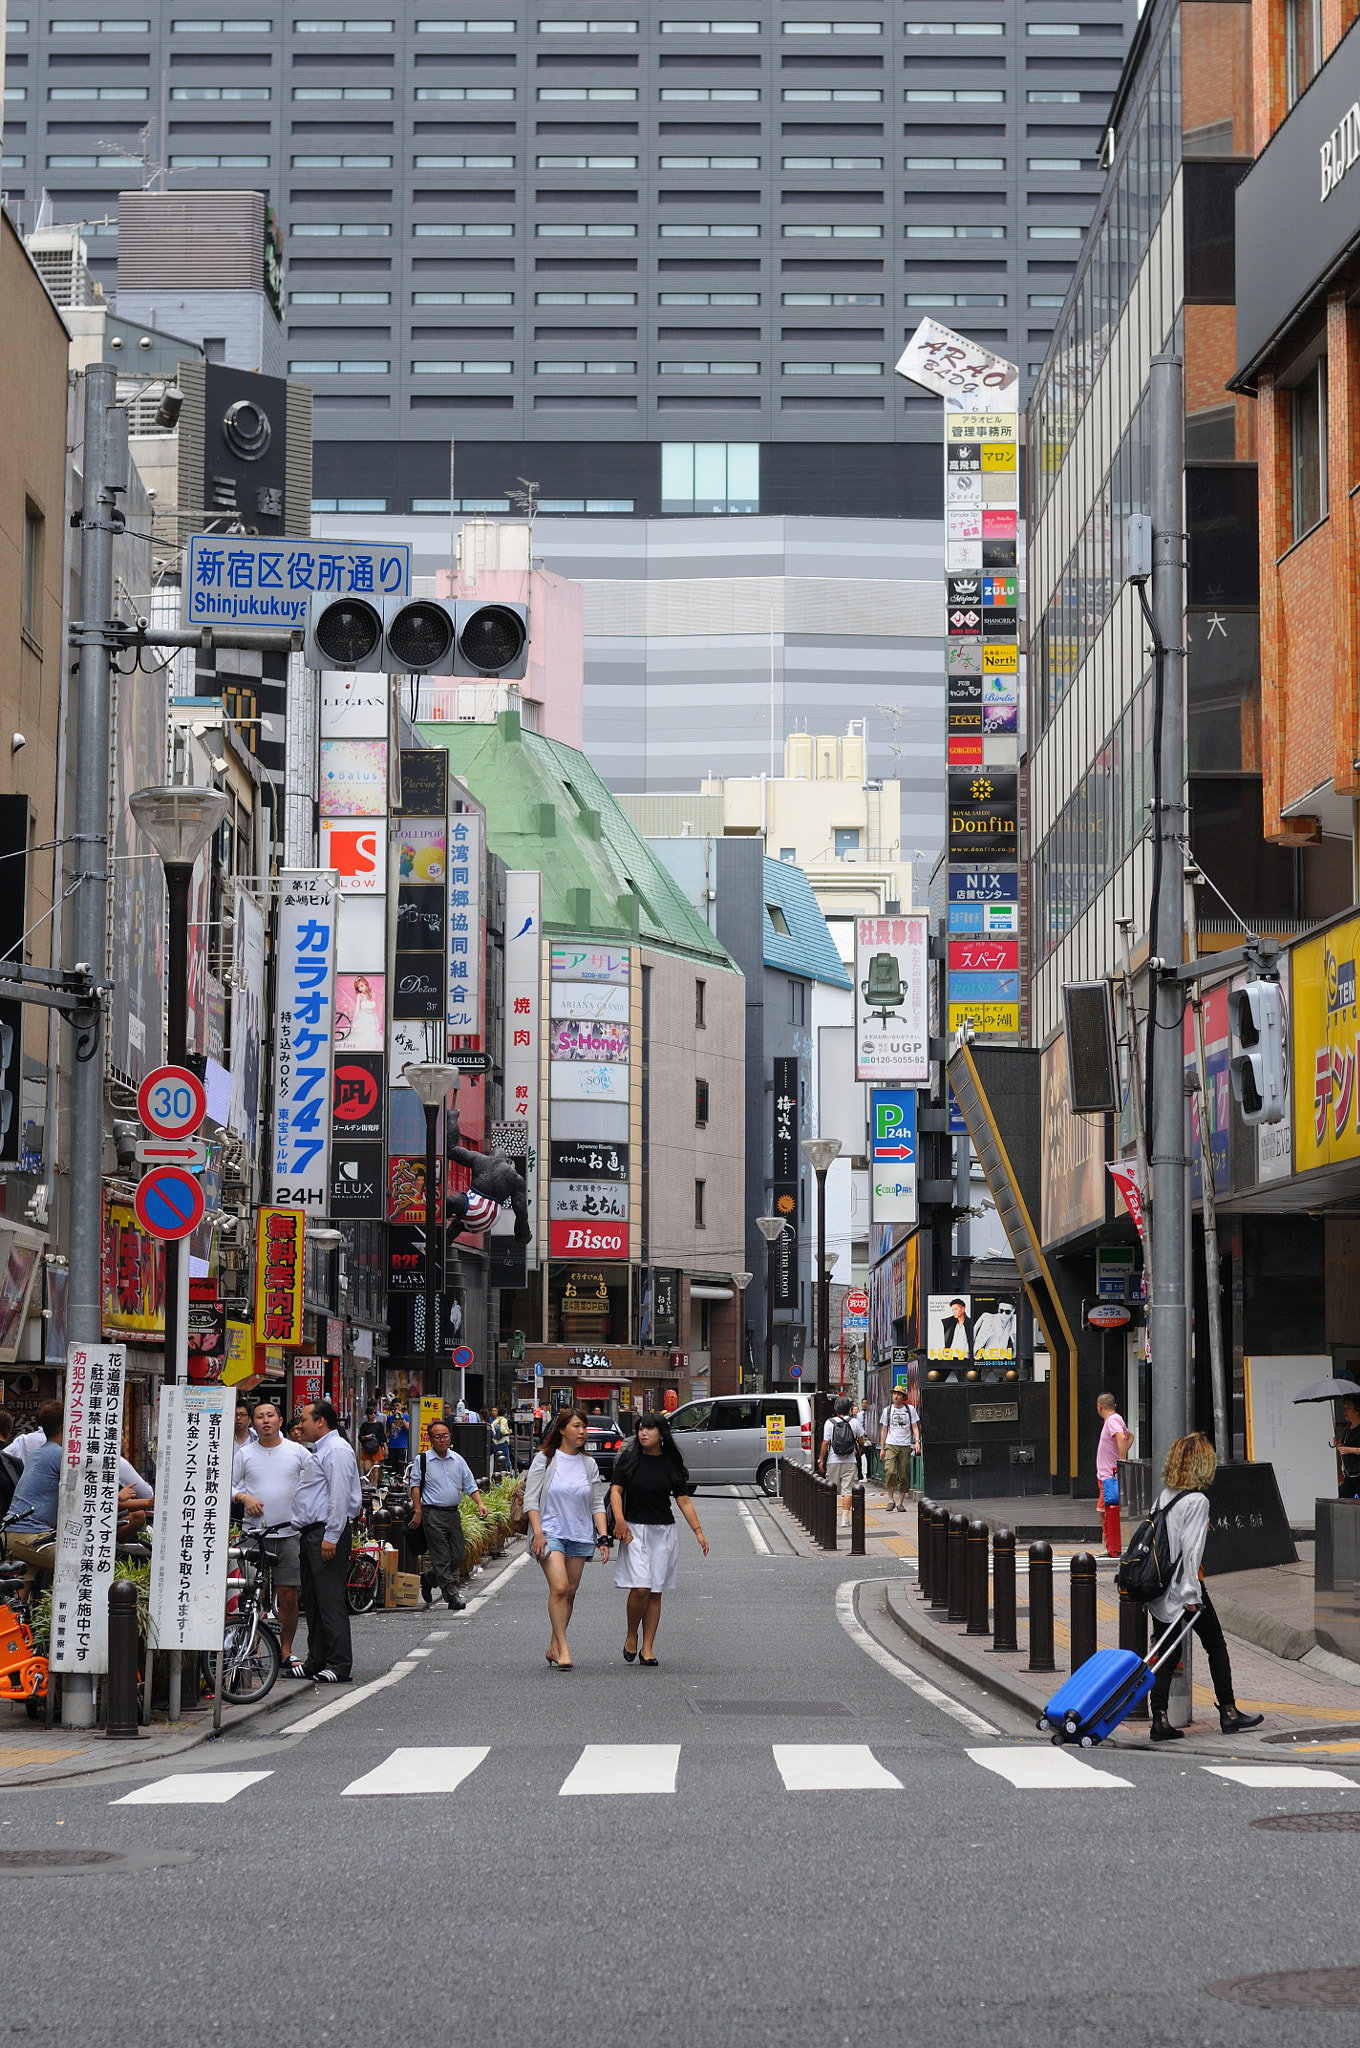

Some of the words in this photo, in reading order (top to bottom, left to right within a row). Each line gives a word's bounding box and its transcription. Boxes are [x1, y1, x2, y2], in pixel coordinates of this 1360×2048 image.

[918, 341, 1006, 388] ARAO
[923, 359, 979, 398] BLDG.
[962, 416, 1002, 424] アラオビル
[951, 426, 1012, 438] 管理事務所
[983, 451, 1015, 462] マロン
[949, 518, 980, 531] テナント
[196, 547, 403, 593] 新宿区役所通り
[984, 655, 1016, 666] North
[949, 746, 982, 755] GORGEOUS
[338, 770, 378, 781] Balus
[321, 819, 334, 830] 3F
[951, 815, 1015, 833] Donfin
[394, 829, 444, 840] LOLLIPOP
[428, 865, 442, 875] 5F
[291, 880, 317, 891] 第12
[966, 874, 1001, 889] NIX
[956, 889, 1011, 900] 店舗センター
[449, 822, 470, 1004] 台湾同郷協同組合
[859, 919, 924, 946] 社長募集
[961, 951, 1007, 970] スパーク
[953, 984, 994, 995] POINT
[1337, 979, 1355, 1006] TEN
[426, 1001, 438, 1011] 3F
[560, 1000, 595, 1010] ARIANA
[447, 1012, 472, 1026] ビル
[513, 997, 531, 1047] 焼肉
[289, 918, 331, 1174] カラオケ747
[890, 1042, 923, 1054] UGP
[870, 1056, 925, 1064] 0120-5055-92
[154, 1087, 191, 1119] 30
[515, 1085, 529, 1122] 叙々
[876, 1103, 904, 1139] P
[888, 1127, 912, 1139] 24h
[276, 1108, 290, 1174] 東宝ビル前
[275, 1187, 323, 1205] 24H
[331, 1183, 374, 1194] ELUX
[556, 1199, 579, 1211] 池袋
[565, 1228, 622, 1250] Bisco
[263, 1212, 298, 1341] 無料案内所
[294, 1357, 320, 1369] 24H
[66, 1351, 87, 1468] 防犯カメラ作動中
[96, 1352, 123, 1573] 花道通りは違法駐車をなくすため
[202, 1412, 223, 1575] 客引きは詐欺の手先です!
[176, 1411, 201, 1644] 料金システムの何十倍も取られます!
[55, 1601, 68, 1661] 新宿警察署
